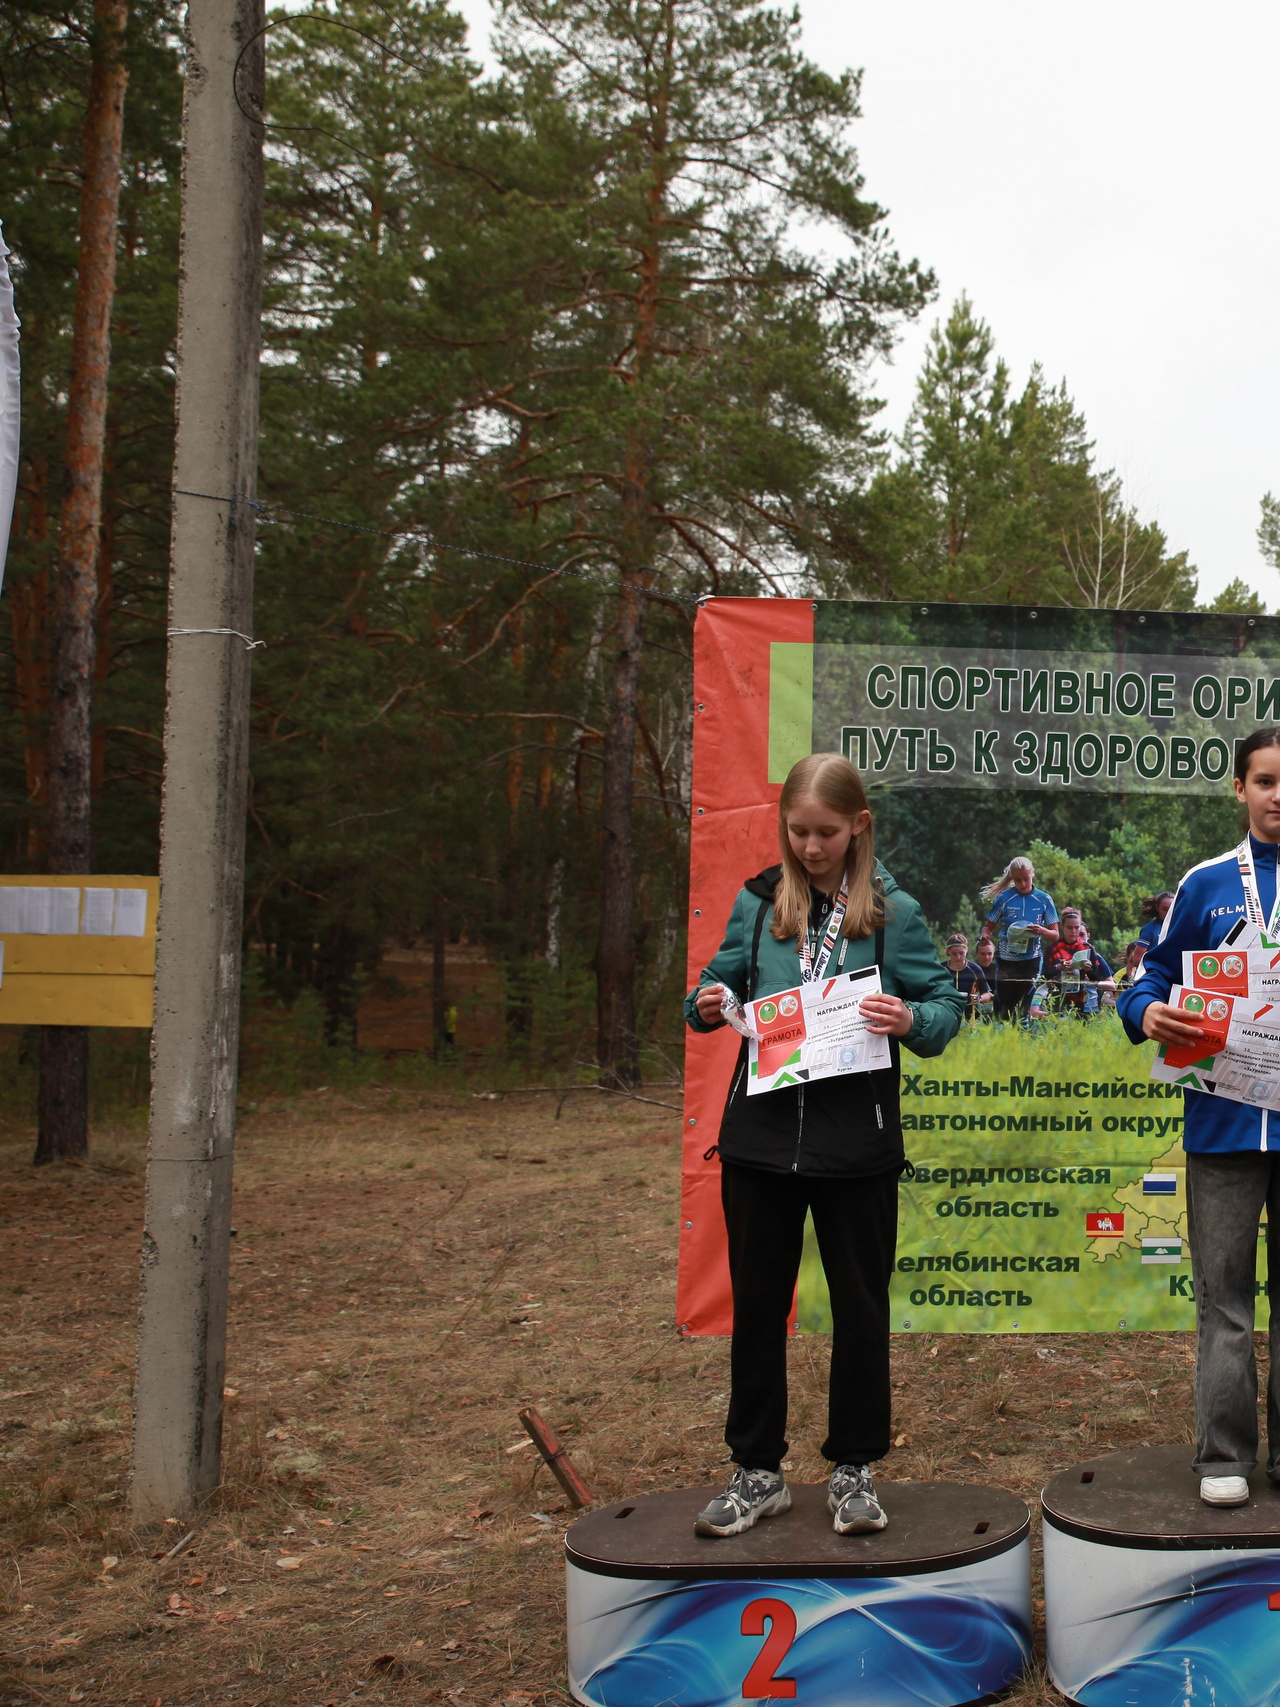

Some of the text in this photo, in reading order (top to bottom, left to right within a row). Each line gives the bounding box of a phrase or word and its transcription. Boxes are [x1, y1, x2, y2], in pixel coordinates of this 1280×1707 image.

[867, 664, 1175, 718] СПОРТИВНОЕ
[841, 726, 956, 773] ПУТЬ
[973, 730, 999, 774] К
[1013, 731, 1246, 785] ЗДОРОВО
[817, 1000, 859, 1016] НАГРАЖДАЕТ
[762, 1028, 803, 1046] ГРАМОТА
[901, 1074, 1182, 1099] Ханты-Мансийски
[901, 1110, 1092, 1132] автономный
[1102, 1115, 1184, 1137] округ
[936, 1196, 1060, 1218] область
[893, 1250, 1080, 1273] елябинская
[910, 1284, 1032, 1307] область
[740, 1598, 798, 1699] 2
